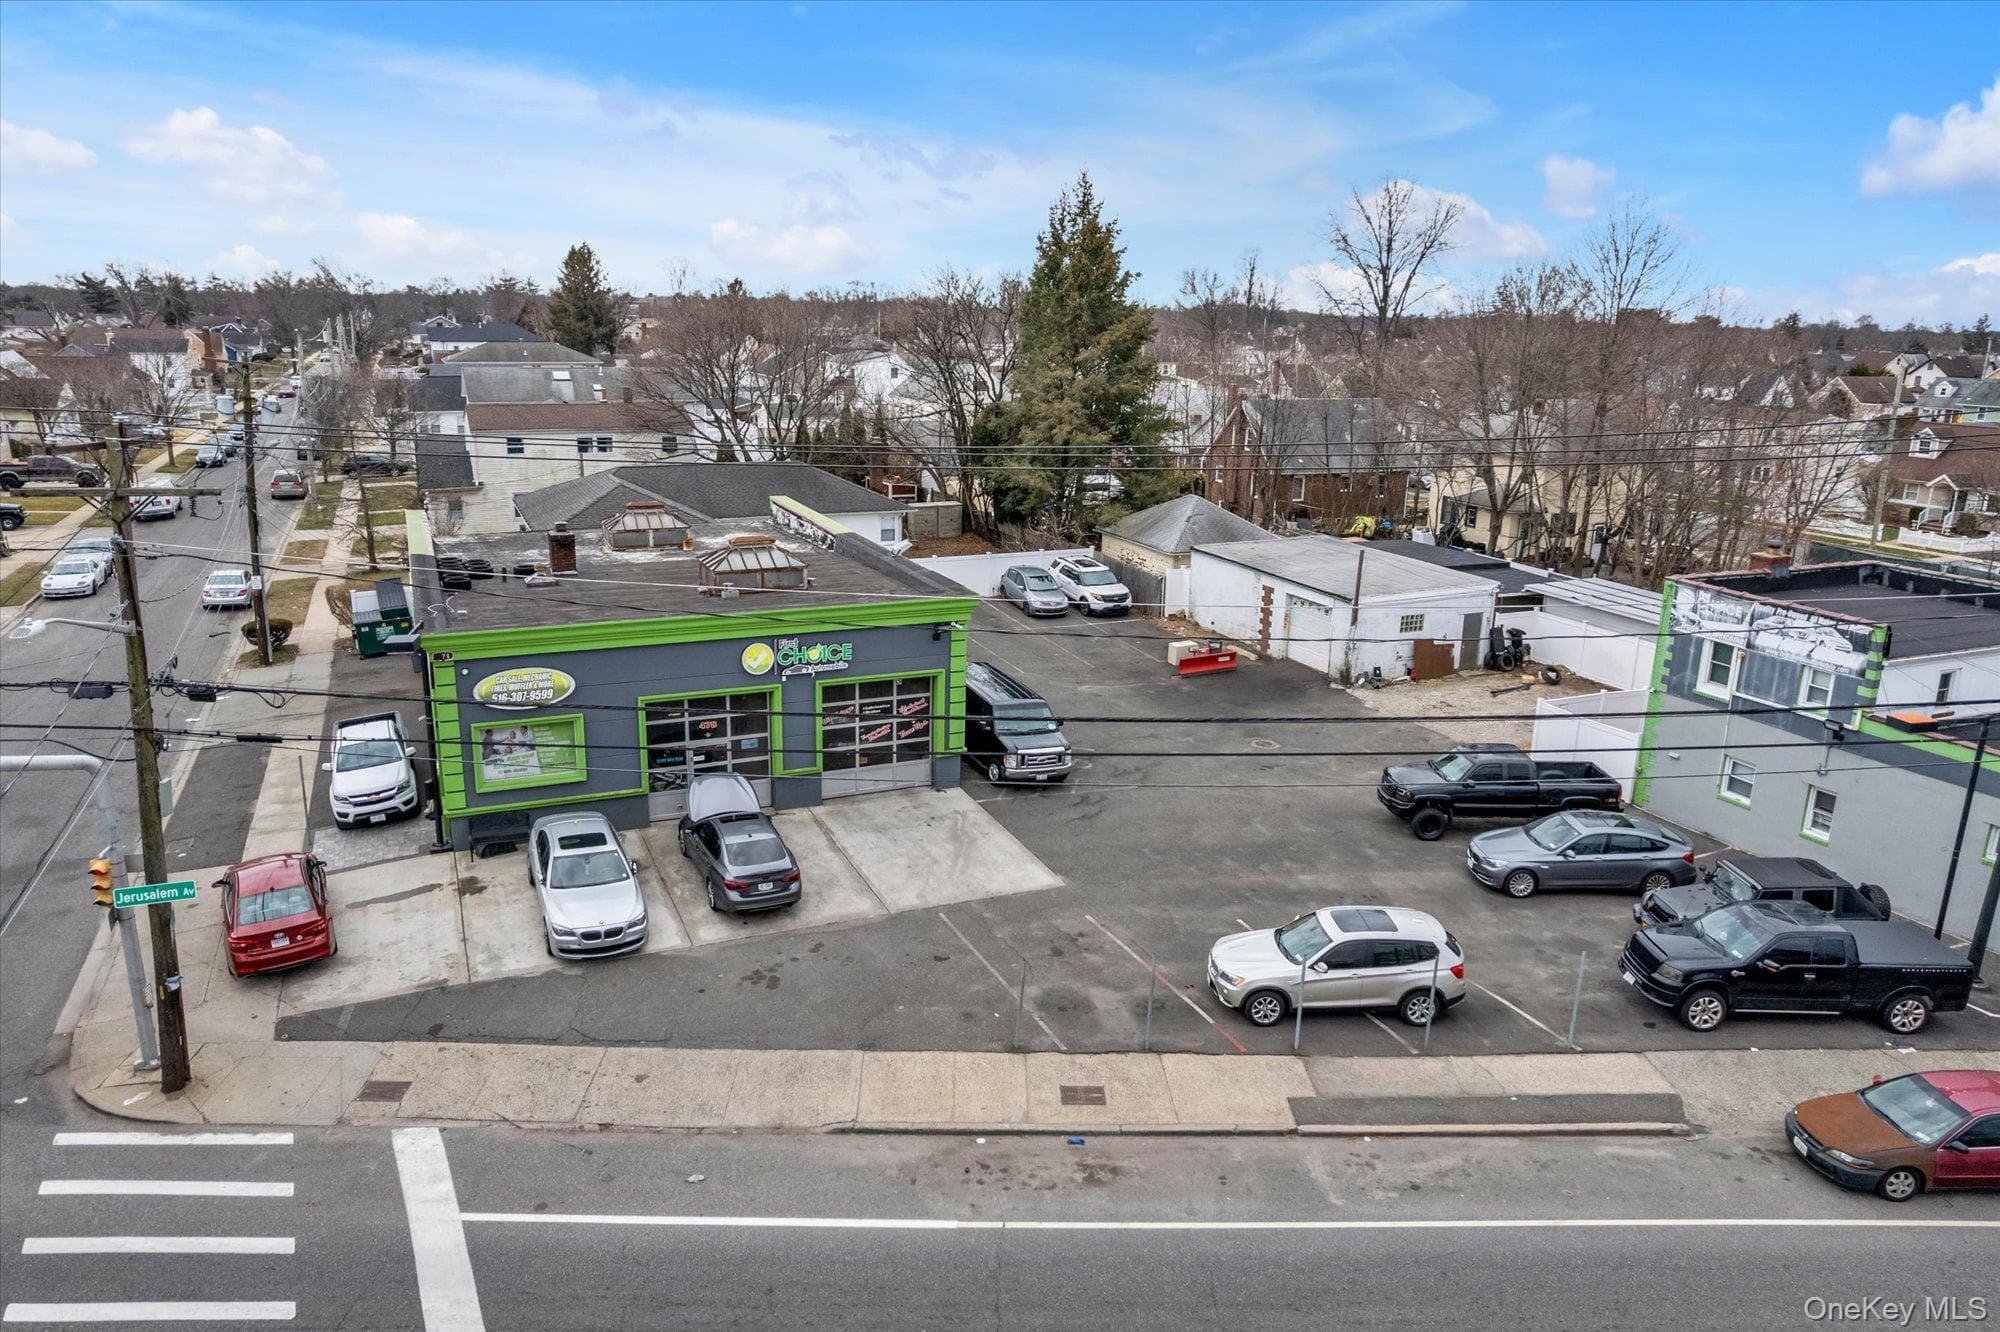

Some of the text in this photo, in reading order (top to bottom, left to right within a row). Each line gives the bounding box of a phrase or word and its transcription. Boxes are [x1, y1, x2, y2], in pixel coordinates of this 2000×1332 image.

[778, 638, 799, 649] First
[777, 642, 853, 666] CHOICE
[810, 660, 848, 672] Automobile
[491, 689, 554, 703] 516-307-9599
[116, 888, 194, 904] Jerusalem Av
